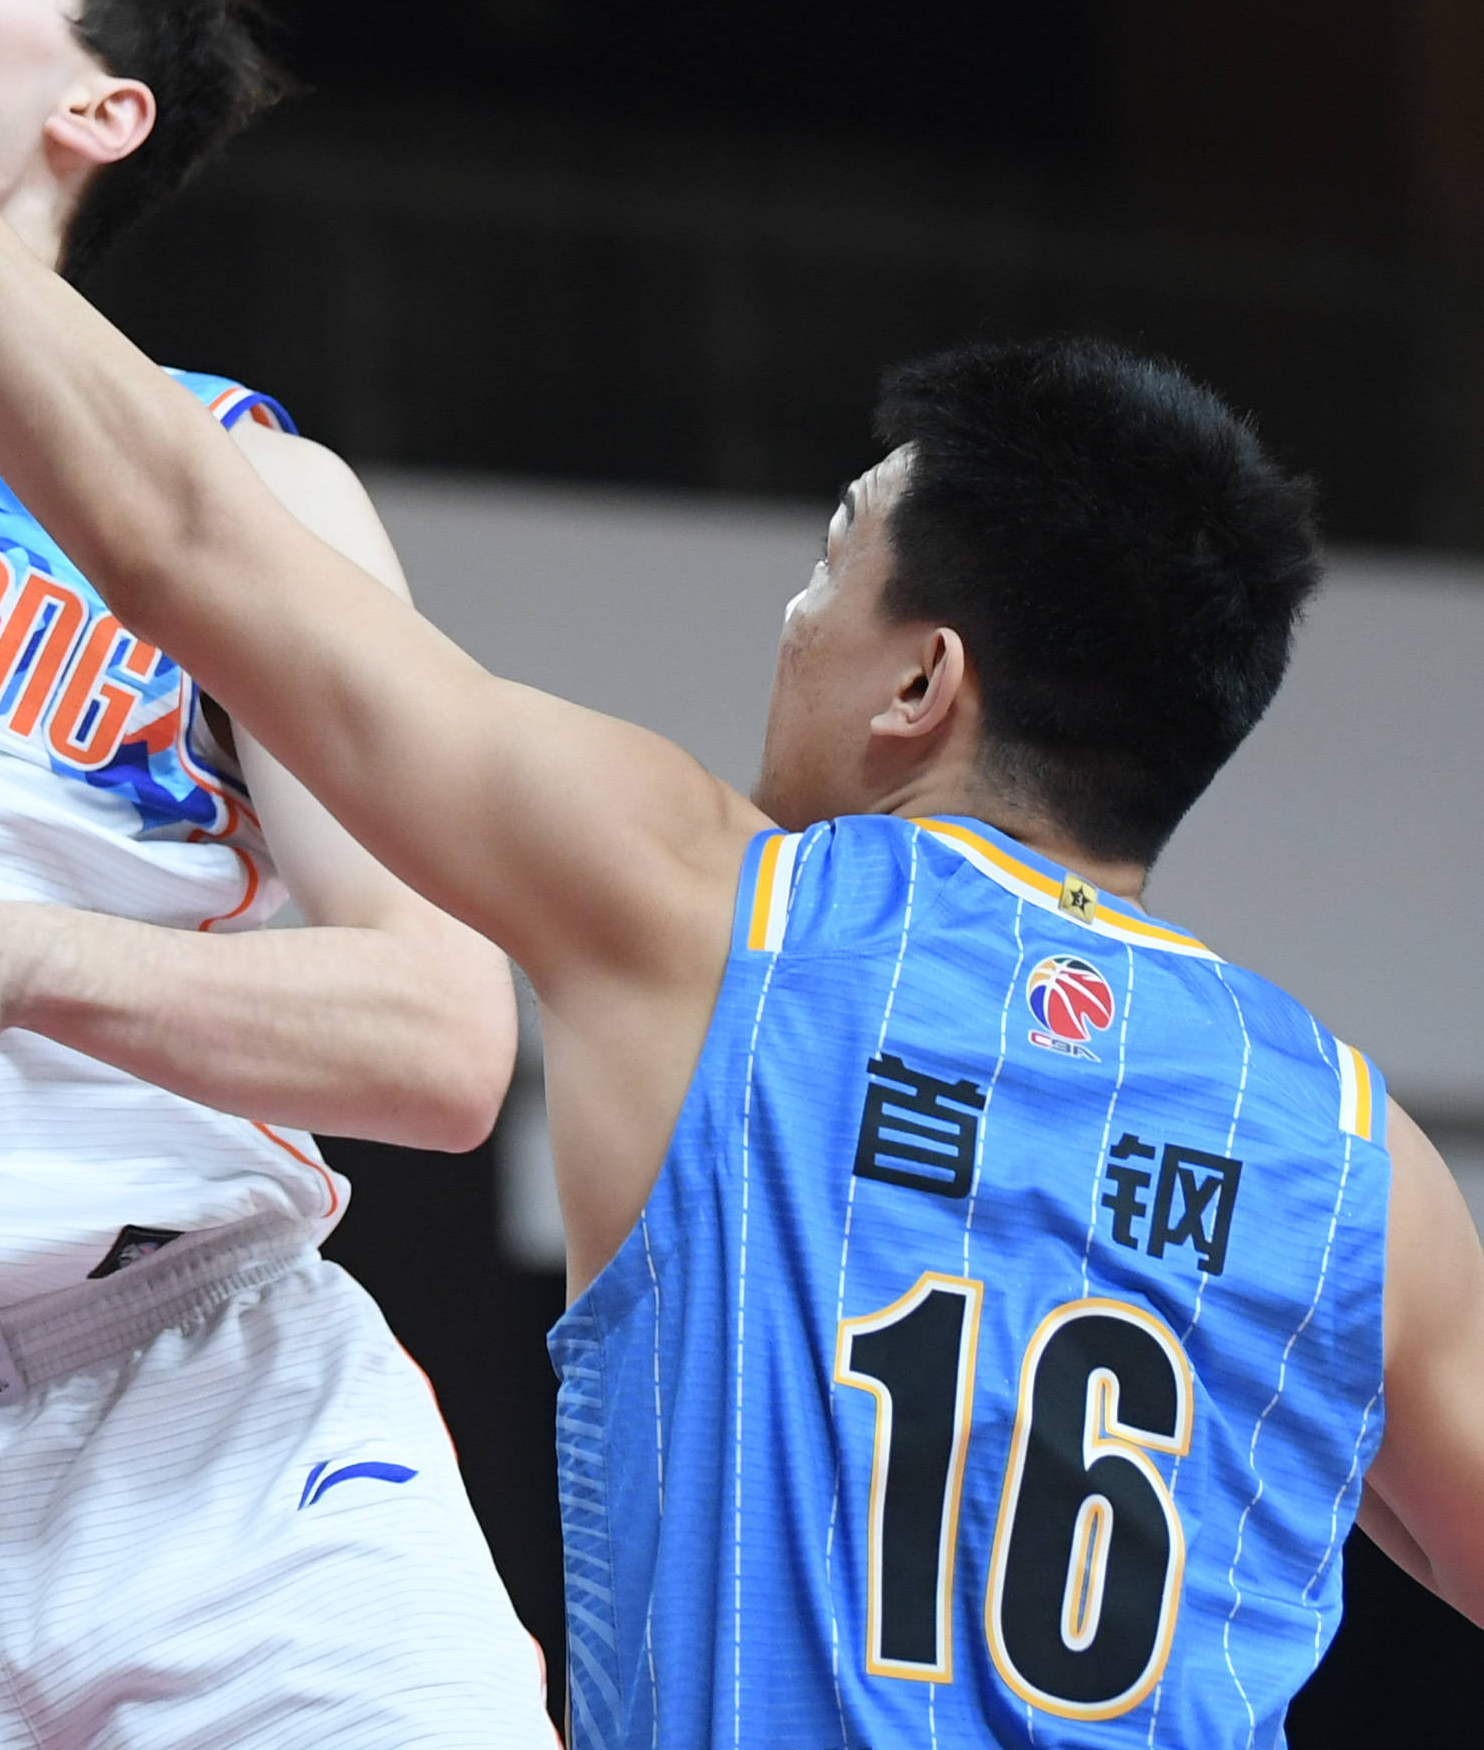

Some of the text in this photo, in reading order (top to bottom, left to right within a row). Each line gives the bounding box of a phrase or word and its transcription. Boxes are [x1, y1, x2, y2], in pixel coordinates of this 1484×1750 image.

[1030, 1030, 1101, 1063] CBA
[852, 1052, 1244, 1277] 首钢
[833, 1270, 1195, 1723] 16
